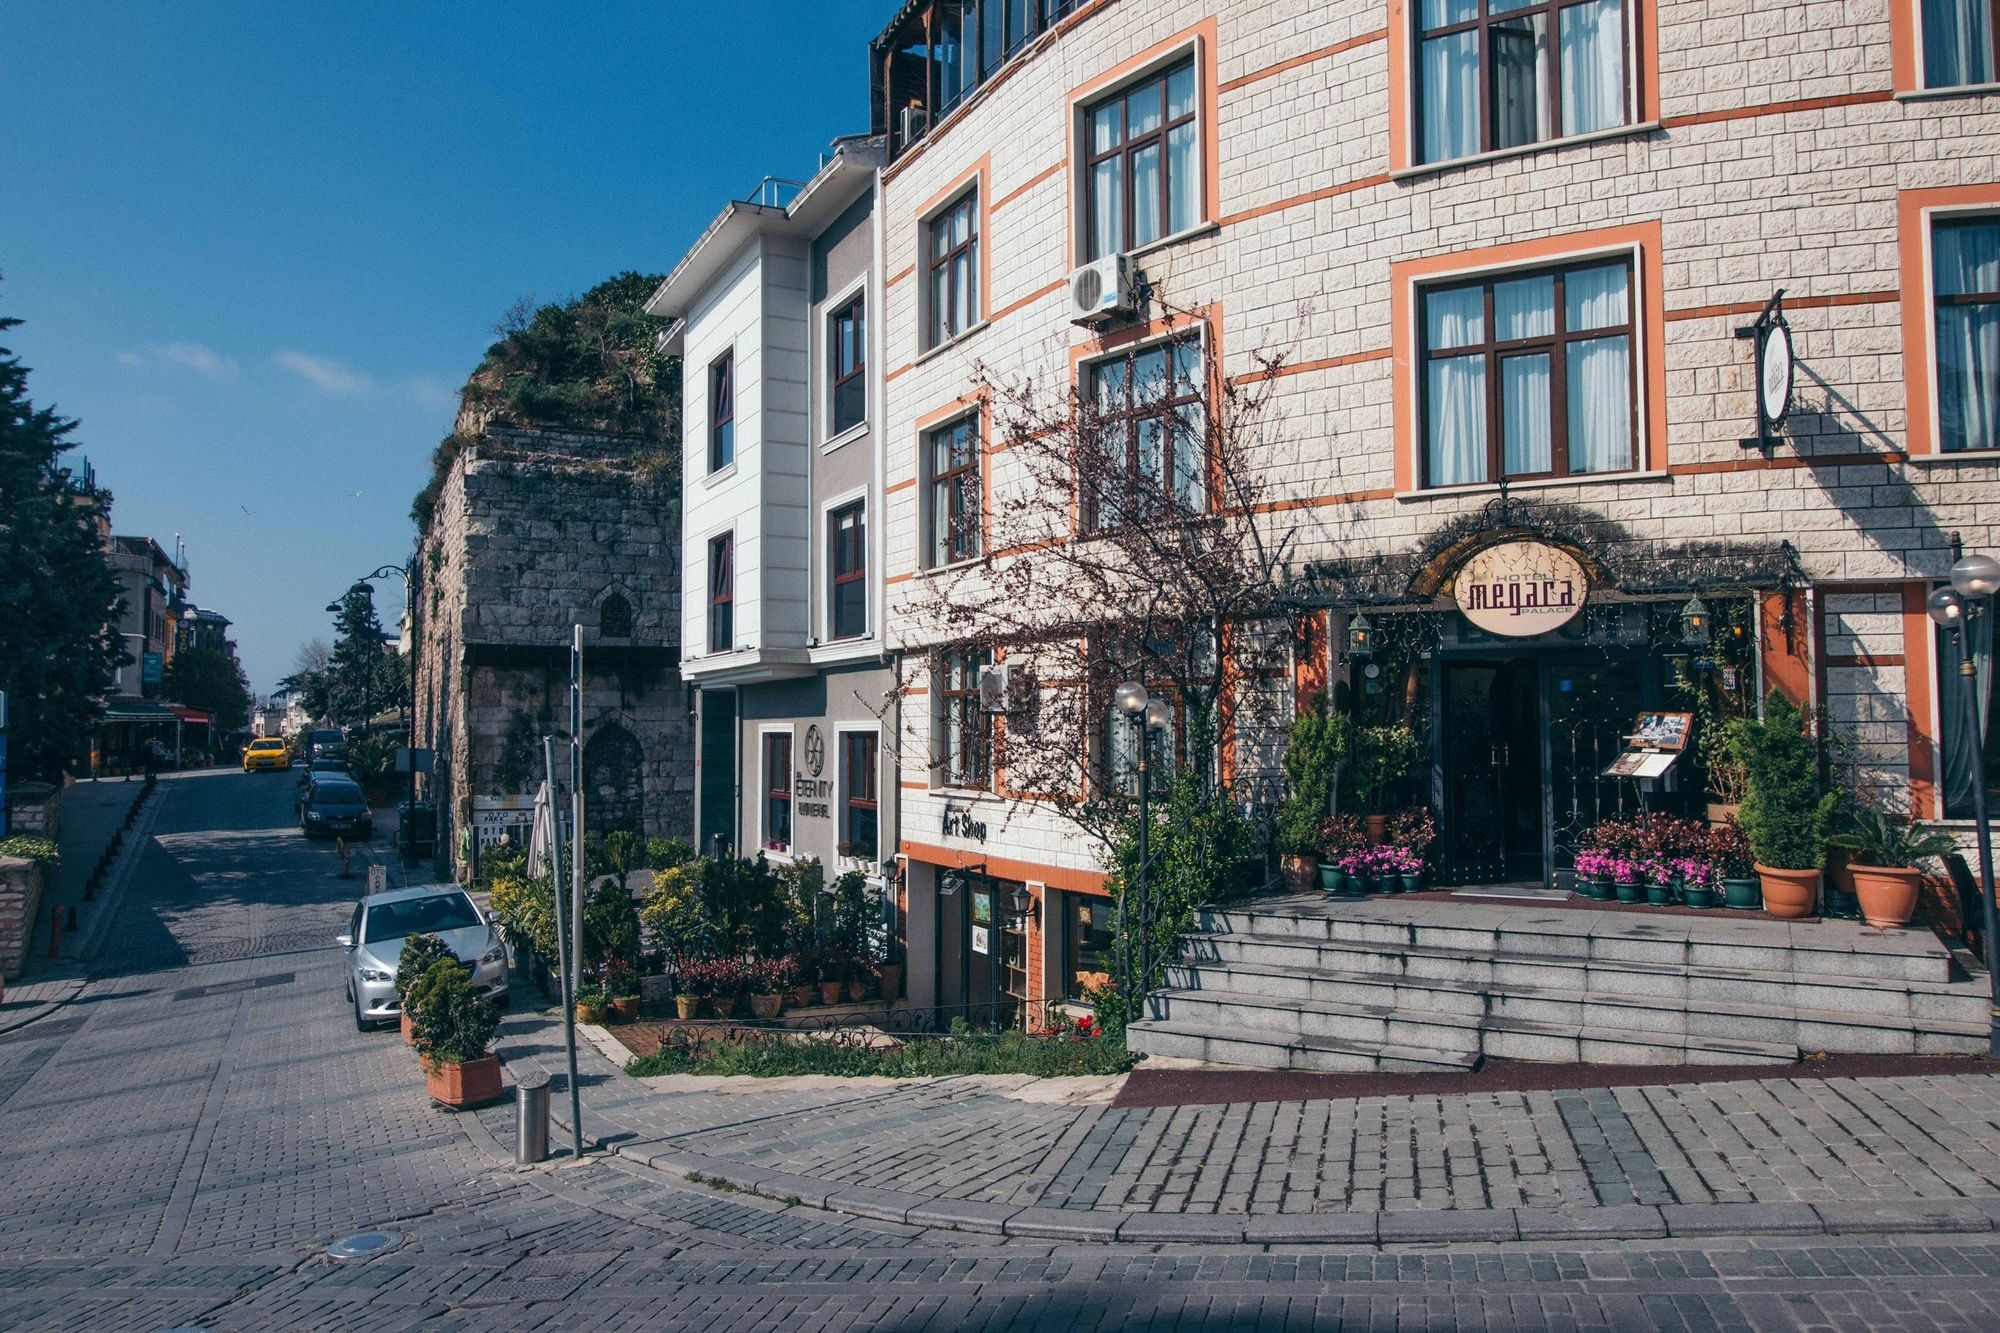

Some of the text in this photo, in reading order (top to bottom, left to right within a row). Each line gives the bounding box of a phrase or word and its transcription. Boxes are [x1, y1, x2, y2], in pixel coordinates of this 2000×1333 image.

[1496, 573, 1552, 582] HOTEL
[1467, 580, 1576, 616] megara
[1522, 607, 1573, 615] PALACE
[483, 827, 504, 835] OTO
[943, 810, 987, 845] Art Shop
